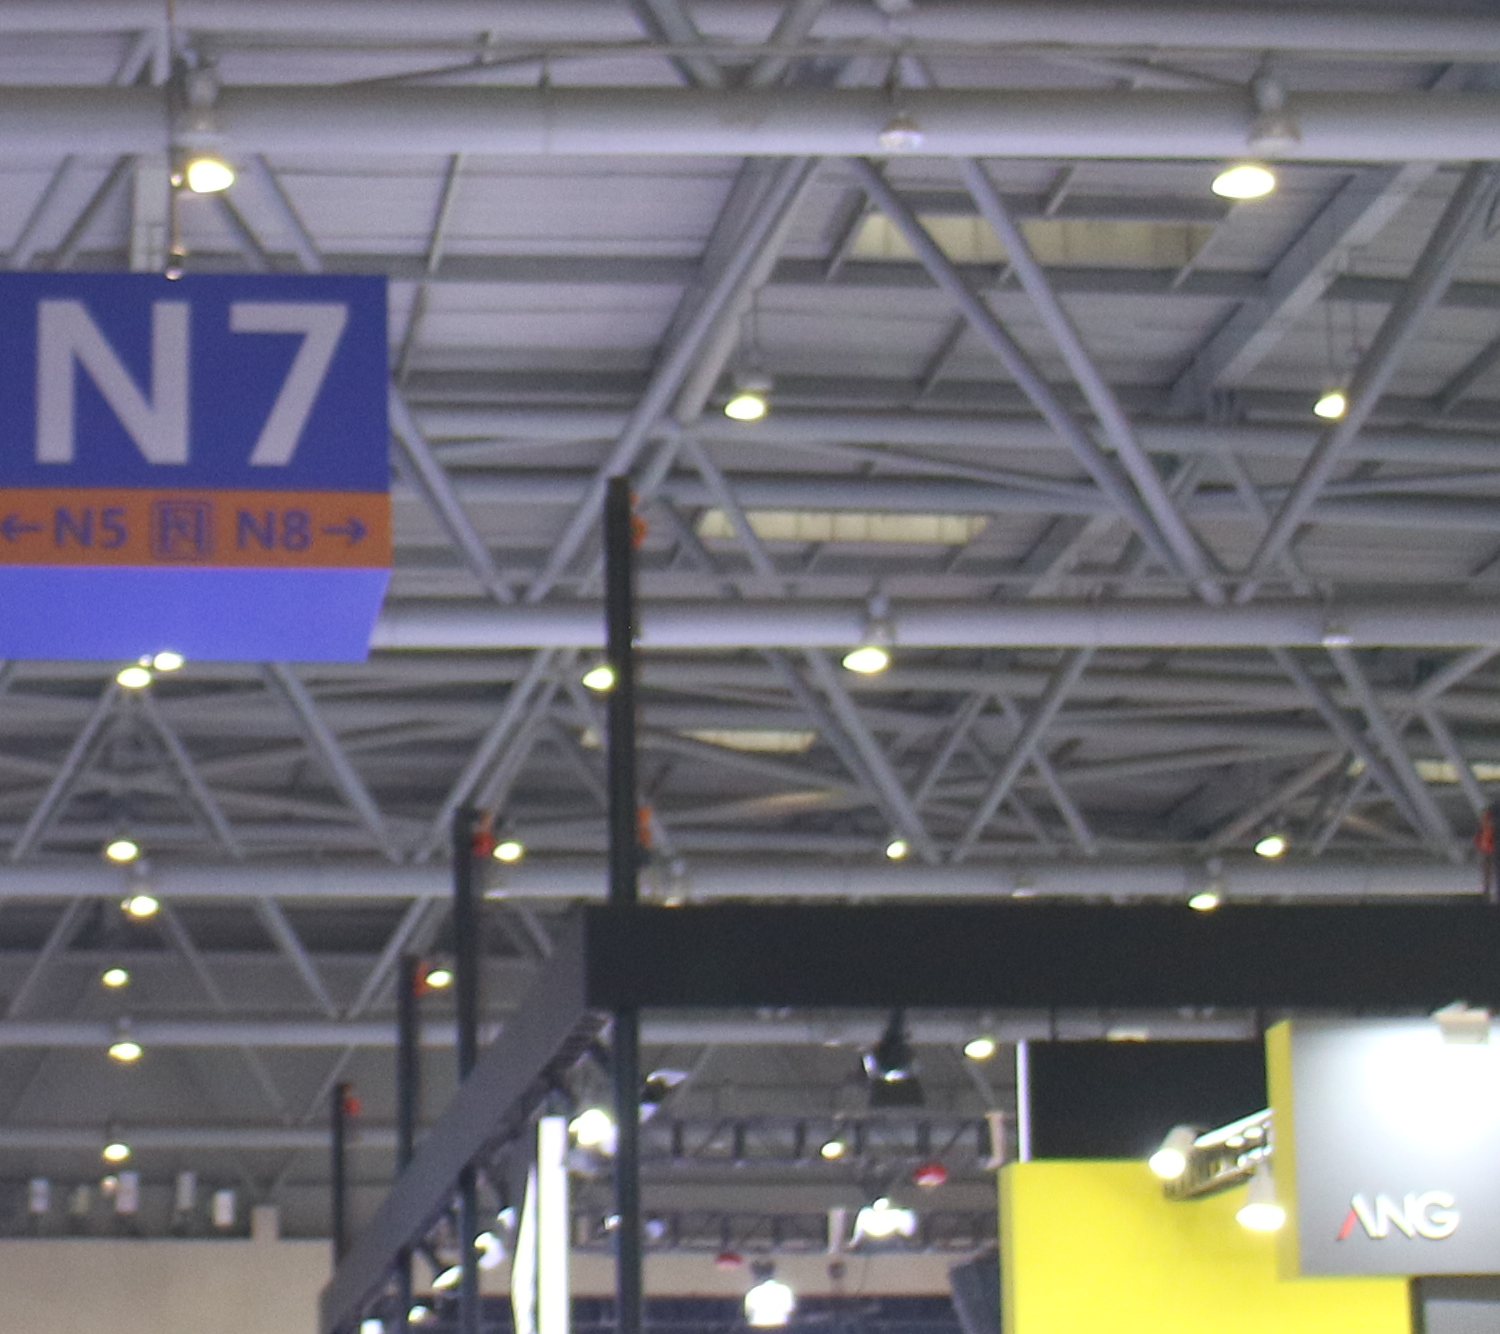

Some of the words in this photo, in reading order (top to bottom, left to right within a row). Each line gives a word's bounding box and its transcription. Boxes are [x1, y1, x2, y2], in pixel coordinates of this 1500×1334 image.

[35, 299, 350, 466] N7
[53, 507, 129, 550] N5
[236, 509, 314, 552] N8
